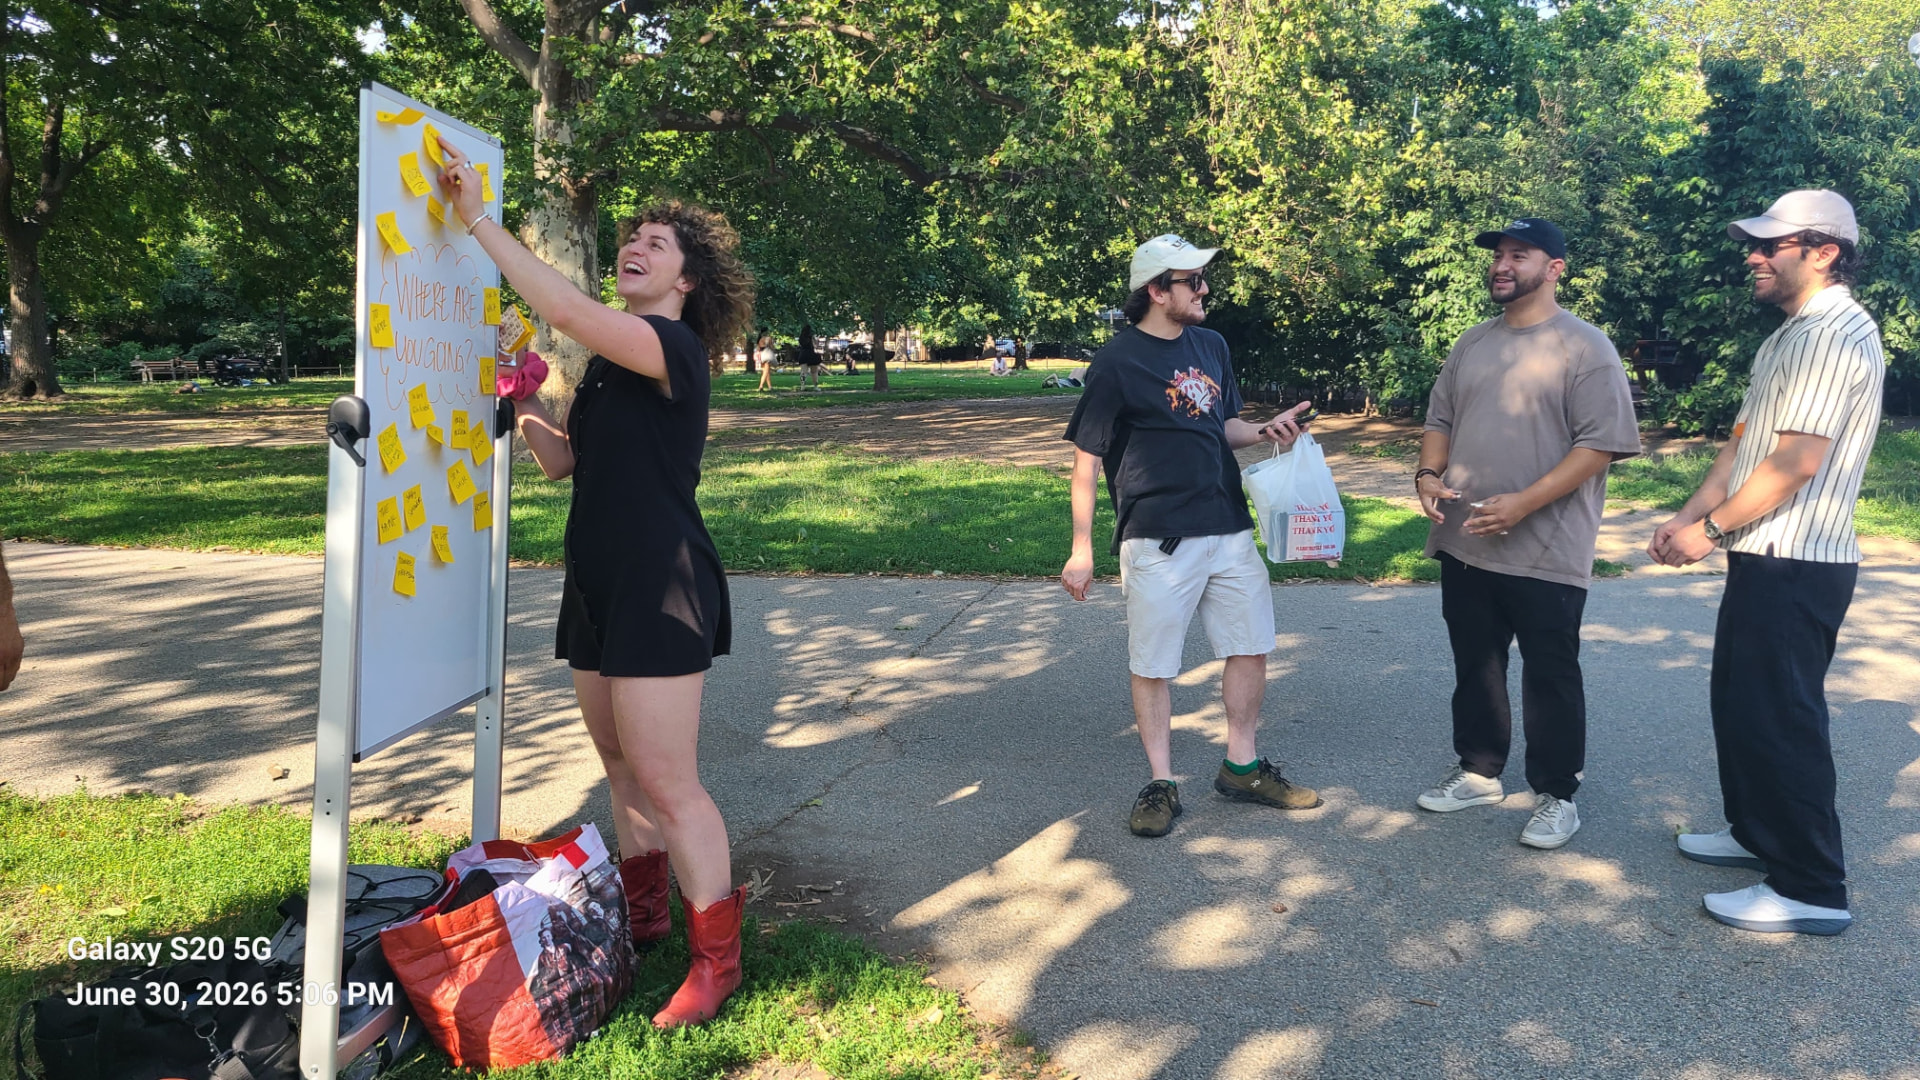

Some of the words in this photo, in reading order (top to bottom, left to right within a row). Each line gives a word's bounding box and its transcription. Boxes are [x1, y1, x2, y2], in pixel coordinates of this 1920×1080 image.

[394, 261, 450, 323] WHERE
[453, 285, 477, 330] ARE
[394, 330, 424, 385] YOU
[423, 336, 474, 375] GOING?
